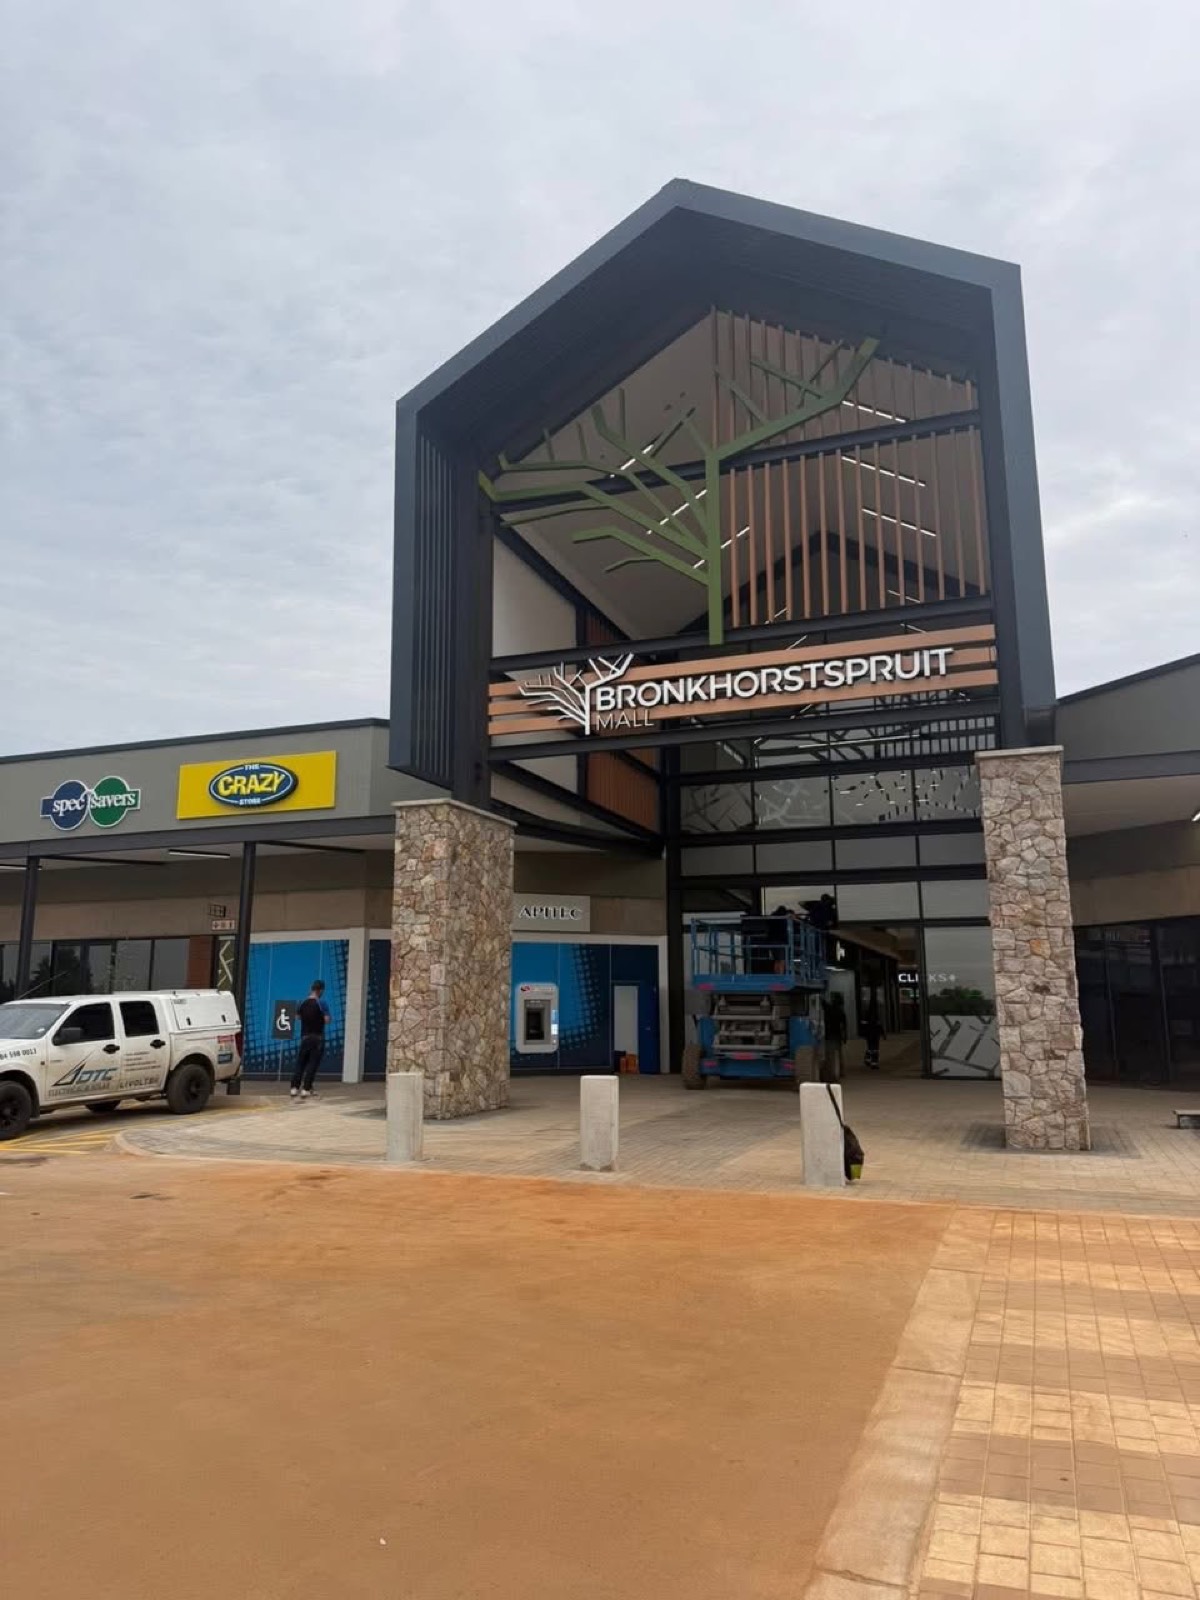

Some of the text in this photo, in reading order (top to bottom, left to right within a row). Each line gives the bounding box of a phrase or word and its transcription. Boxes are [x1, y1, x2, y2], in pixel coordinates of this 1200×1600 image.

[595, 647, 954, 711] BRONKHORSTSPRUIT
[595, 710, 654, 731] MALL
[217, 770, 285, 797] CRAZY
[52, 793, 136, 817] spec savers
[898, 973, 947, 983] CLIKS
